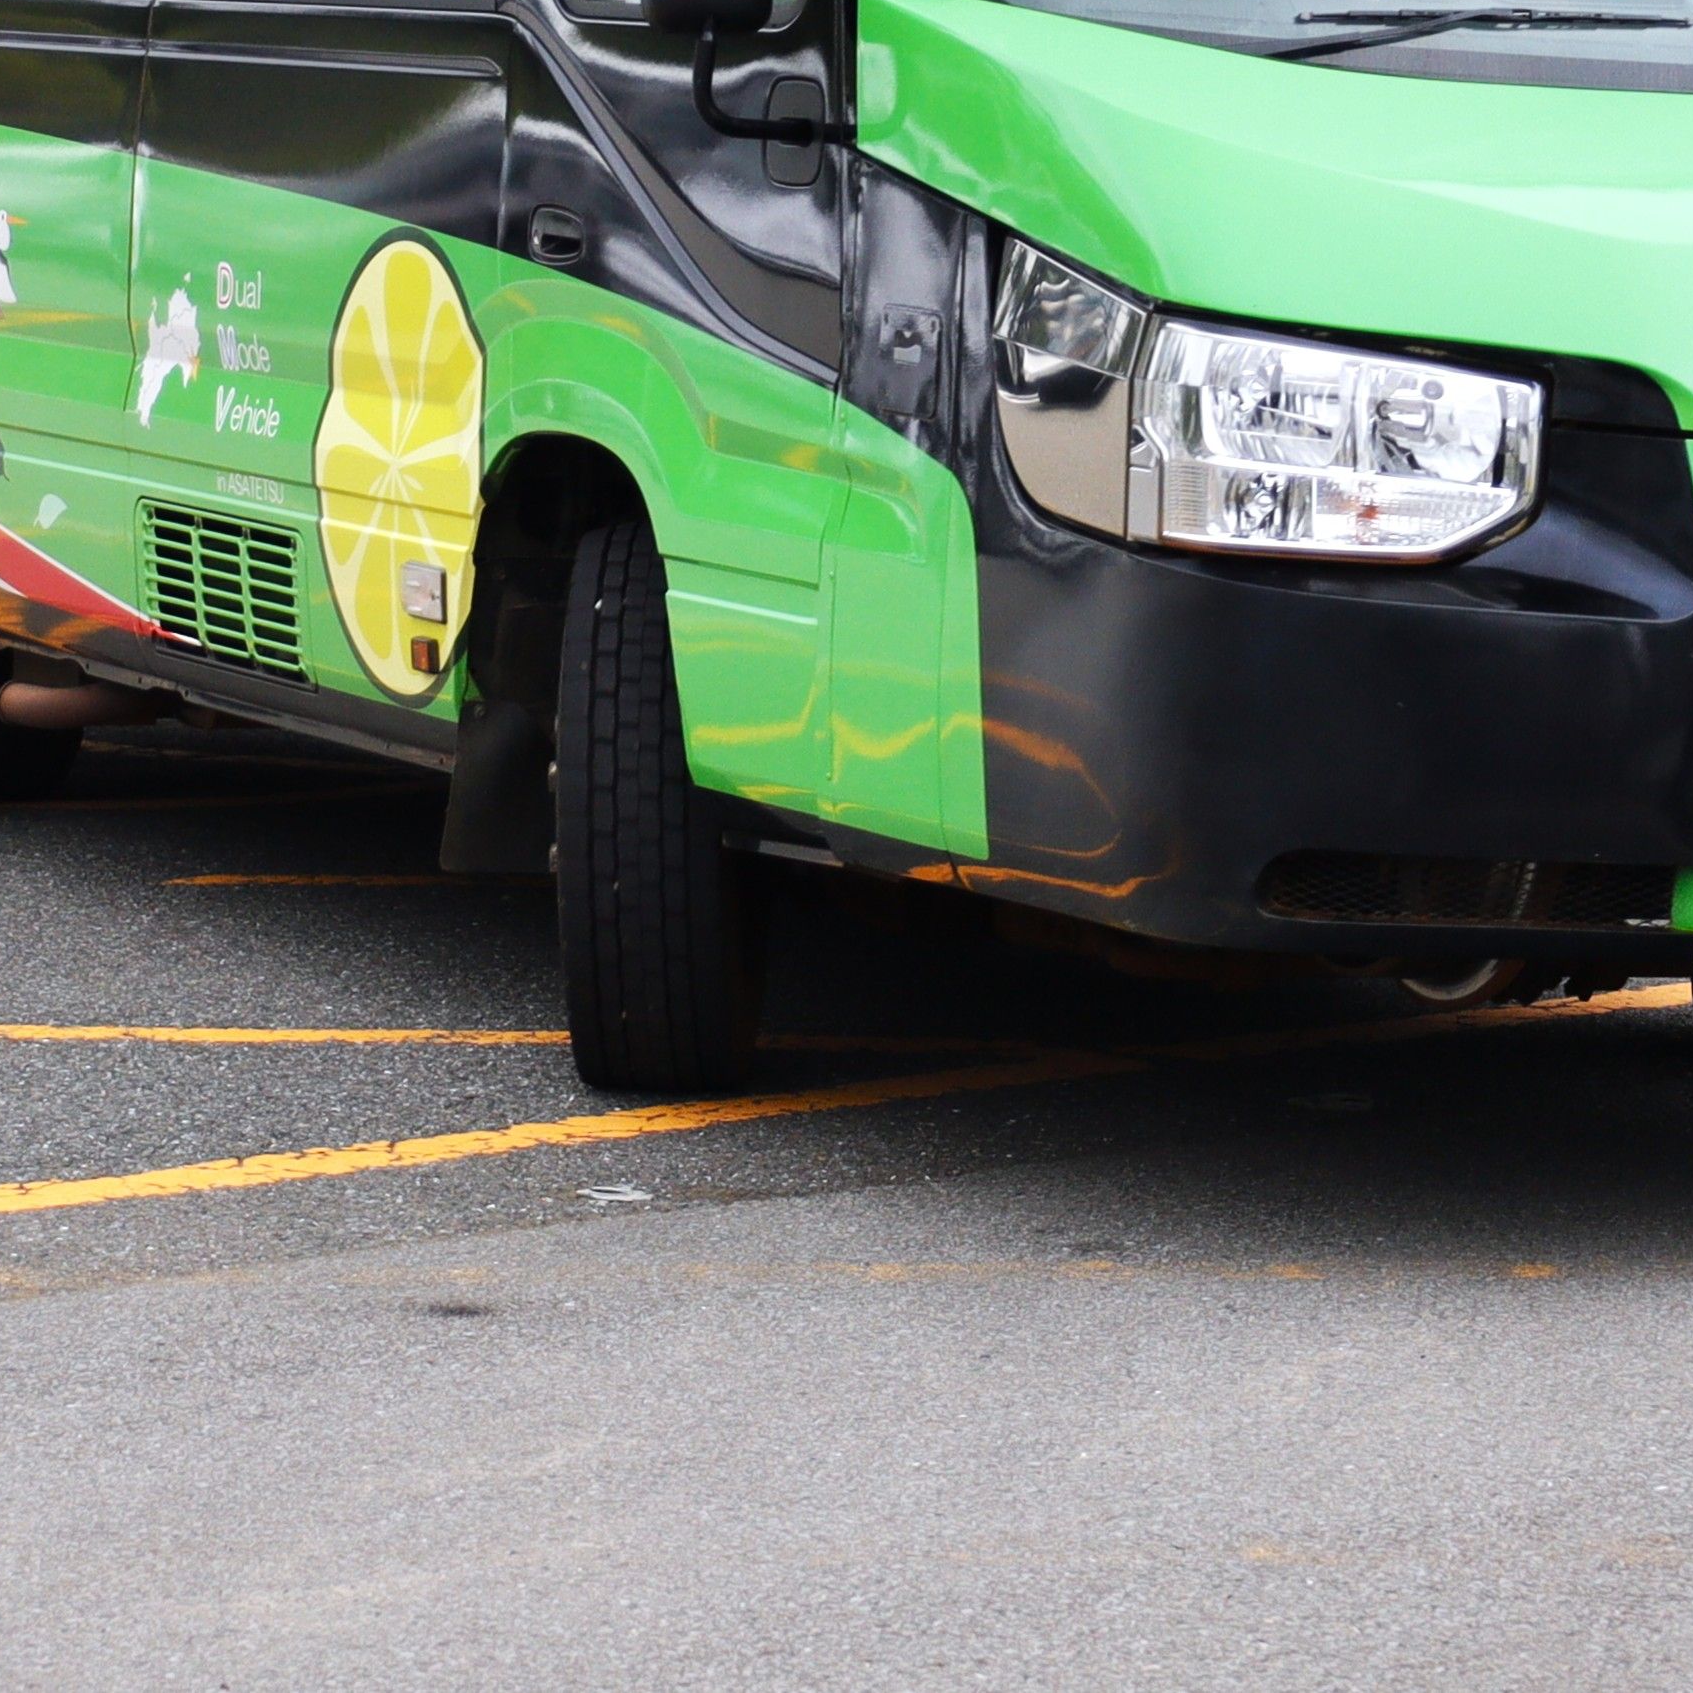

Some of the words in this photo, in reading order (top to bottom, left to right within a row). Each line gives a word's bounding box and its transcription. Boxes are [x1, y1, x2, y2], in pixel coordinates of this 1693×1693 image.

[216, 260, 263, 310] Dual
[216, 323, 271, 373] Mode
[215, 384, 281, 438] Vehicle
[217, 471, 228, 492] in
[228, 472, 284, 505] ASATETSU
